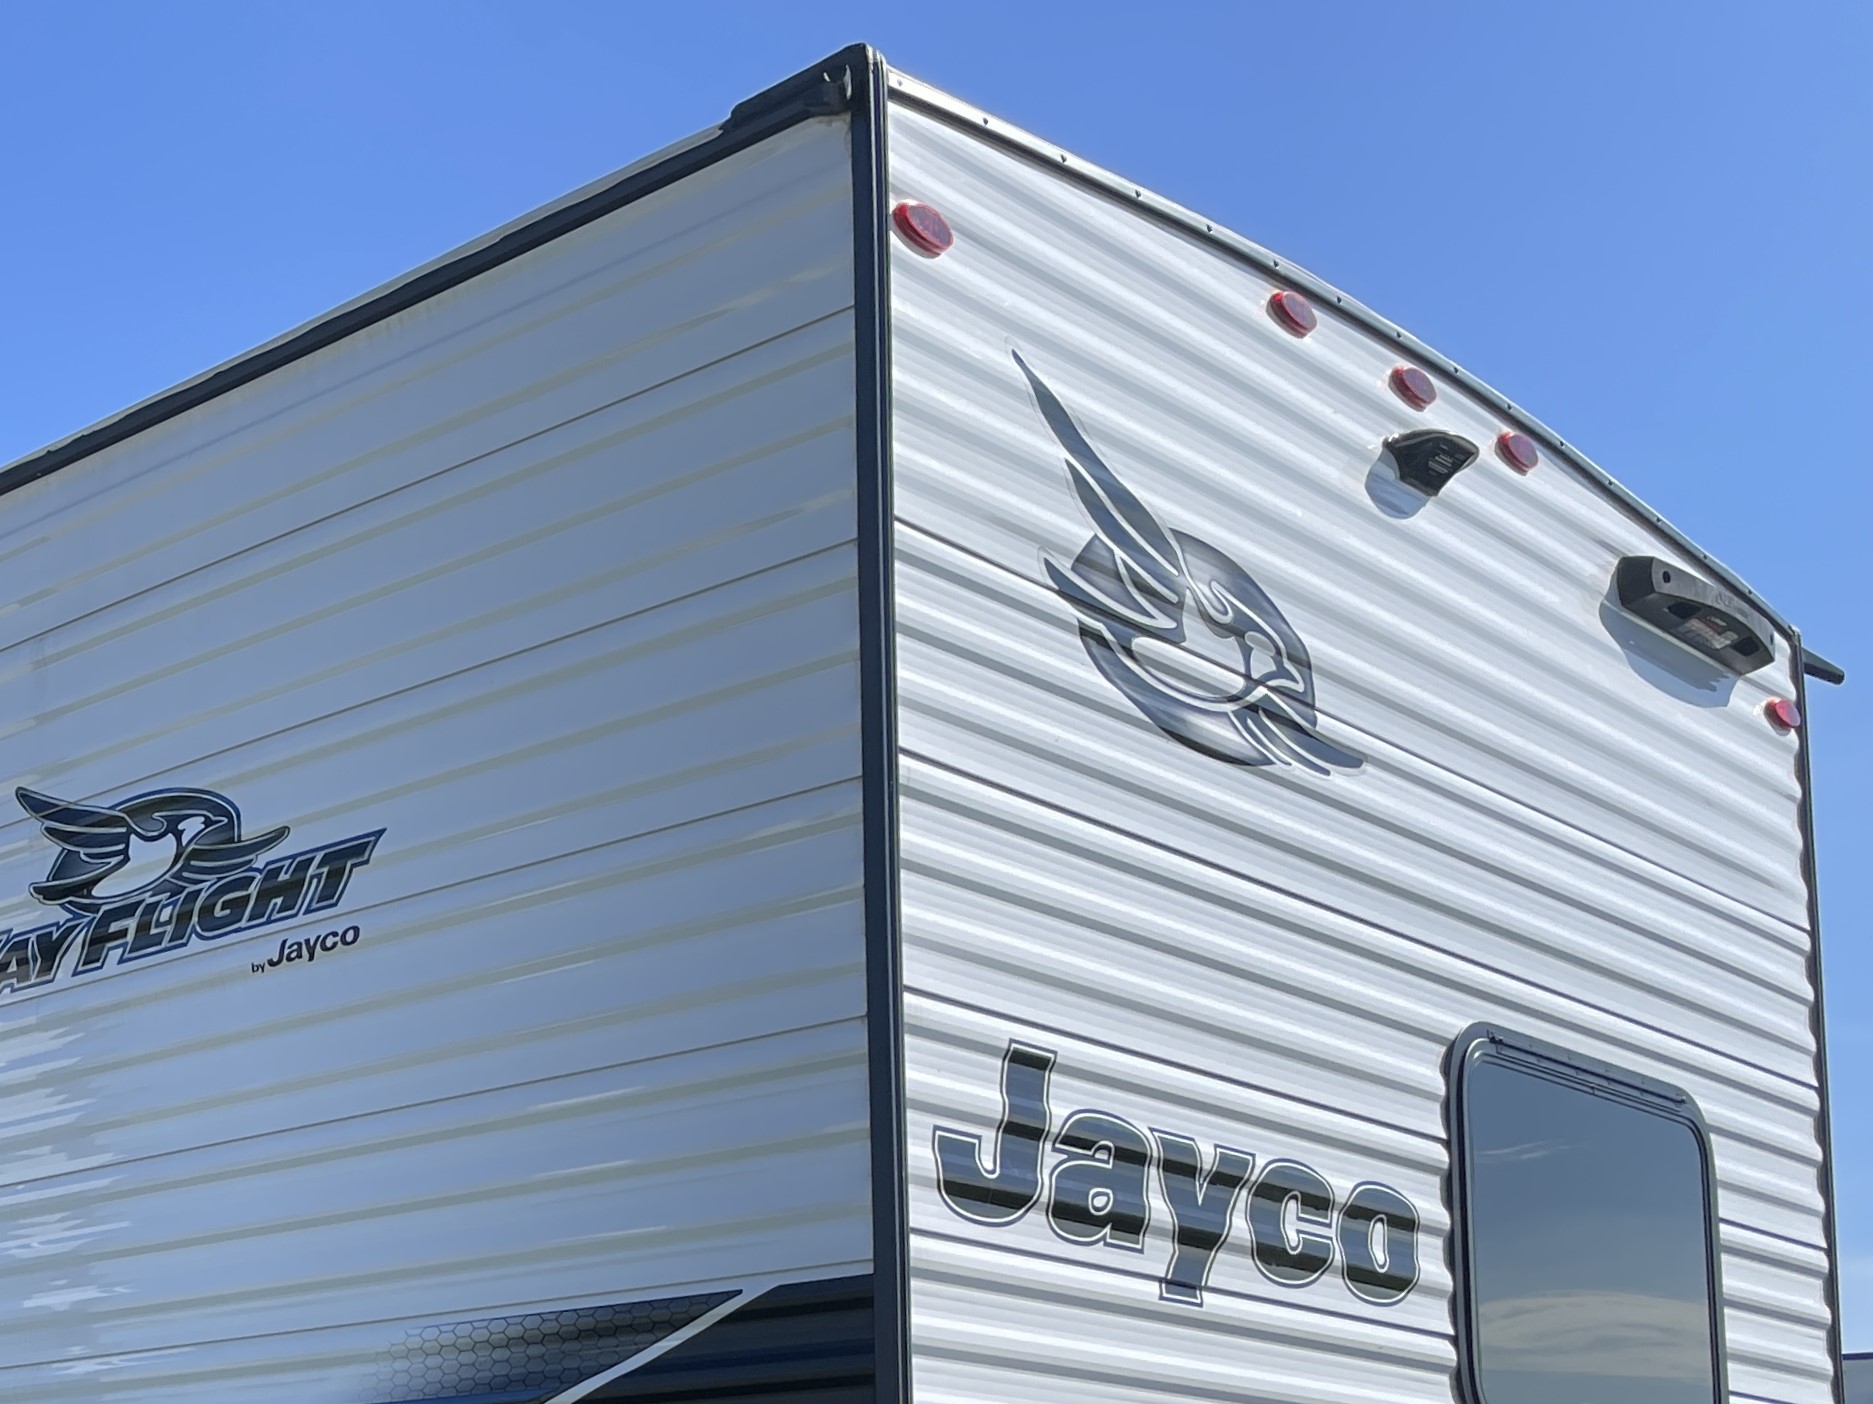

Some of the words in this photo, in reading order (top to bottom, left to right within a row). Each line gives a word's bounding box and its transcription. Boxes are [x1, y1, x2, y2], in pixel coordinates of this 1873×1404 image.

[251, 961, 266, 975] by
[267, 924, 361, 968] Jayco
[932, 1038, 1421, 1307] Jayco
